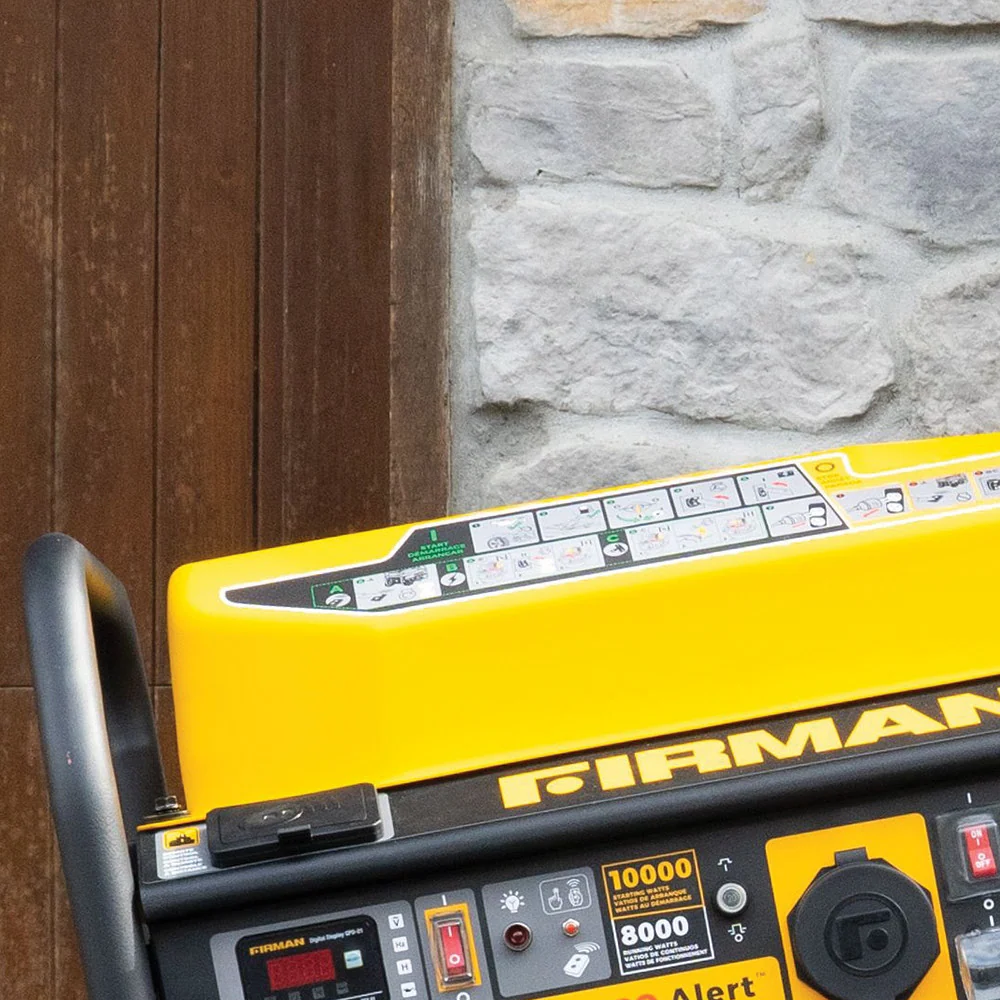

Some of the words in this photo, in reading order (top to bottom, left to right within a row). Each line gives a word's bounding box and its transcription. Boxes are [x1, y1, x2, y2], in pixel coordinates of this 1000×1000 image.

[970, 829, 983, 839] ON
[975, 859, 990, 869] OFF
[608, 858, 691, 890] 10000
[621, 916, 688, 945] 8000
[249, 938, 305, 955] FIRMAN
